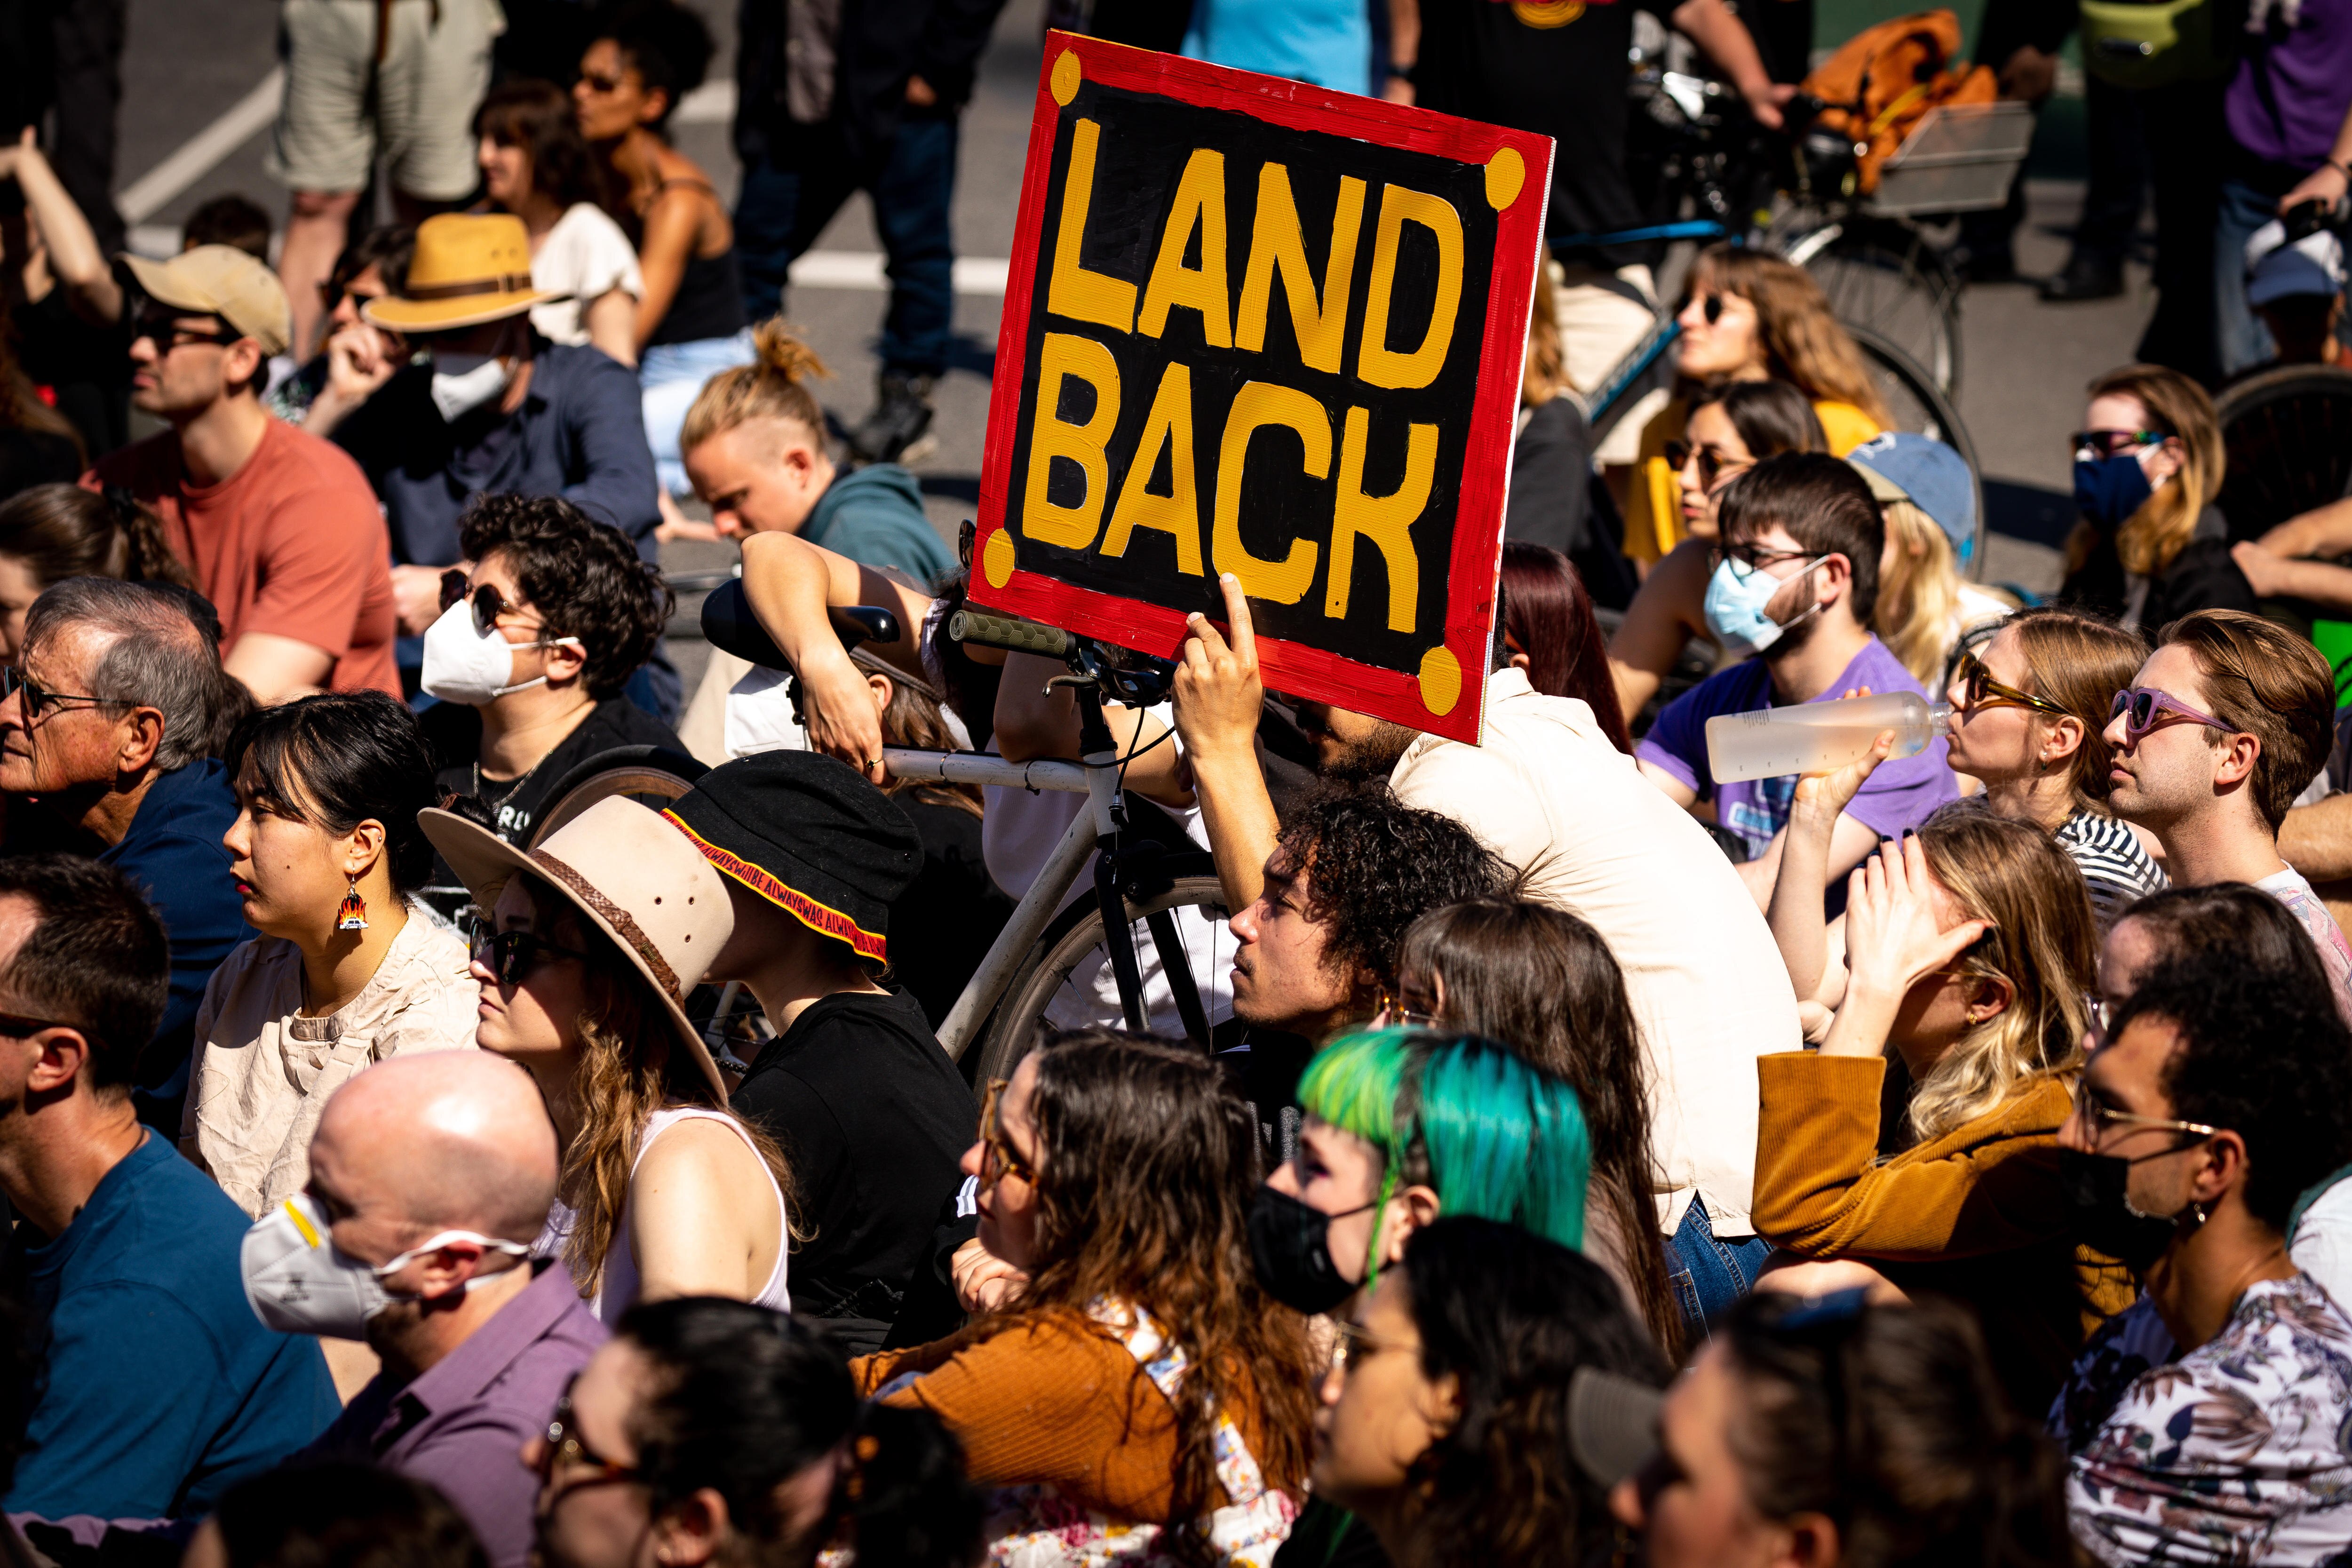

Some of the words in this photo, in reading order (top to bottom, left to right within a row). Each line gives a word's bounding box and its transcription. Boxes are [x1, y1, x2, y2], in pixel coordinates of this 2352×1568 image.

[1048, 118, 1464, 389] LAND
[1022, 332, 1439, 633] BACK
[701, 847, 738, 871] ALWAYS
[751, 869, 764, 889] BE
[764, 879, 803, 913] ALWAYS
[803, 899, 823, 927] WAS
